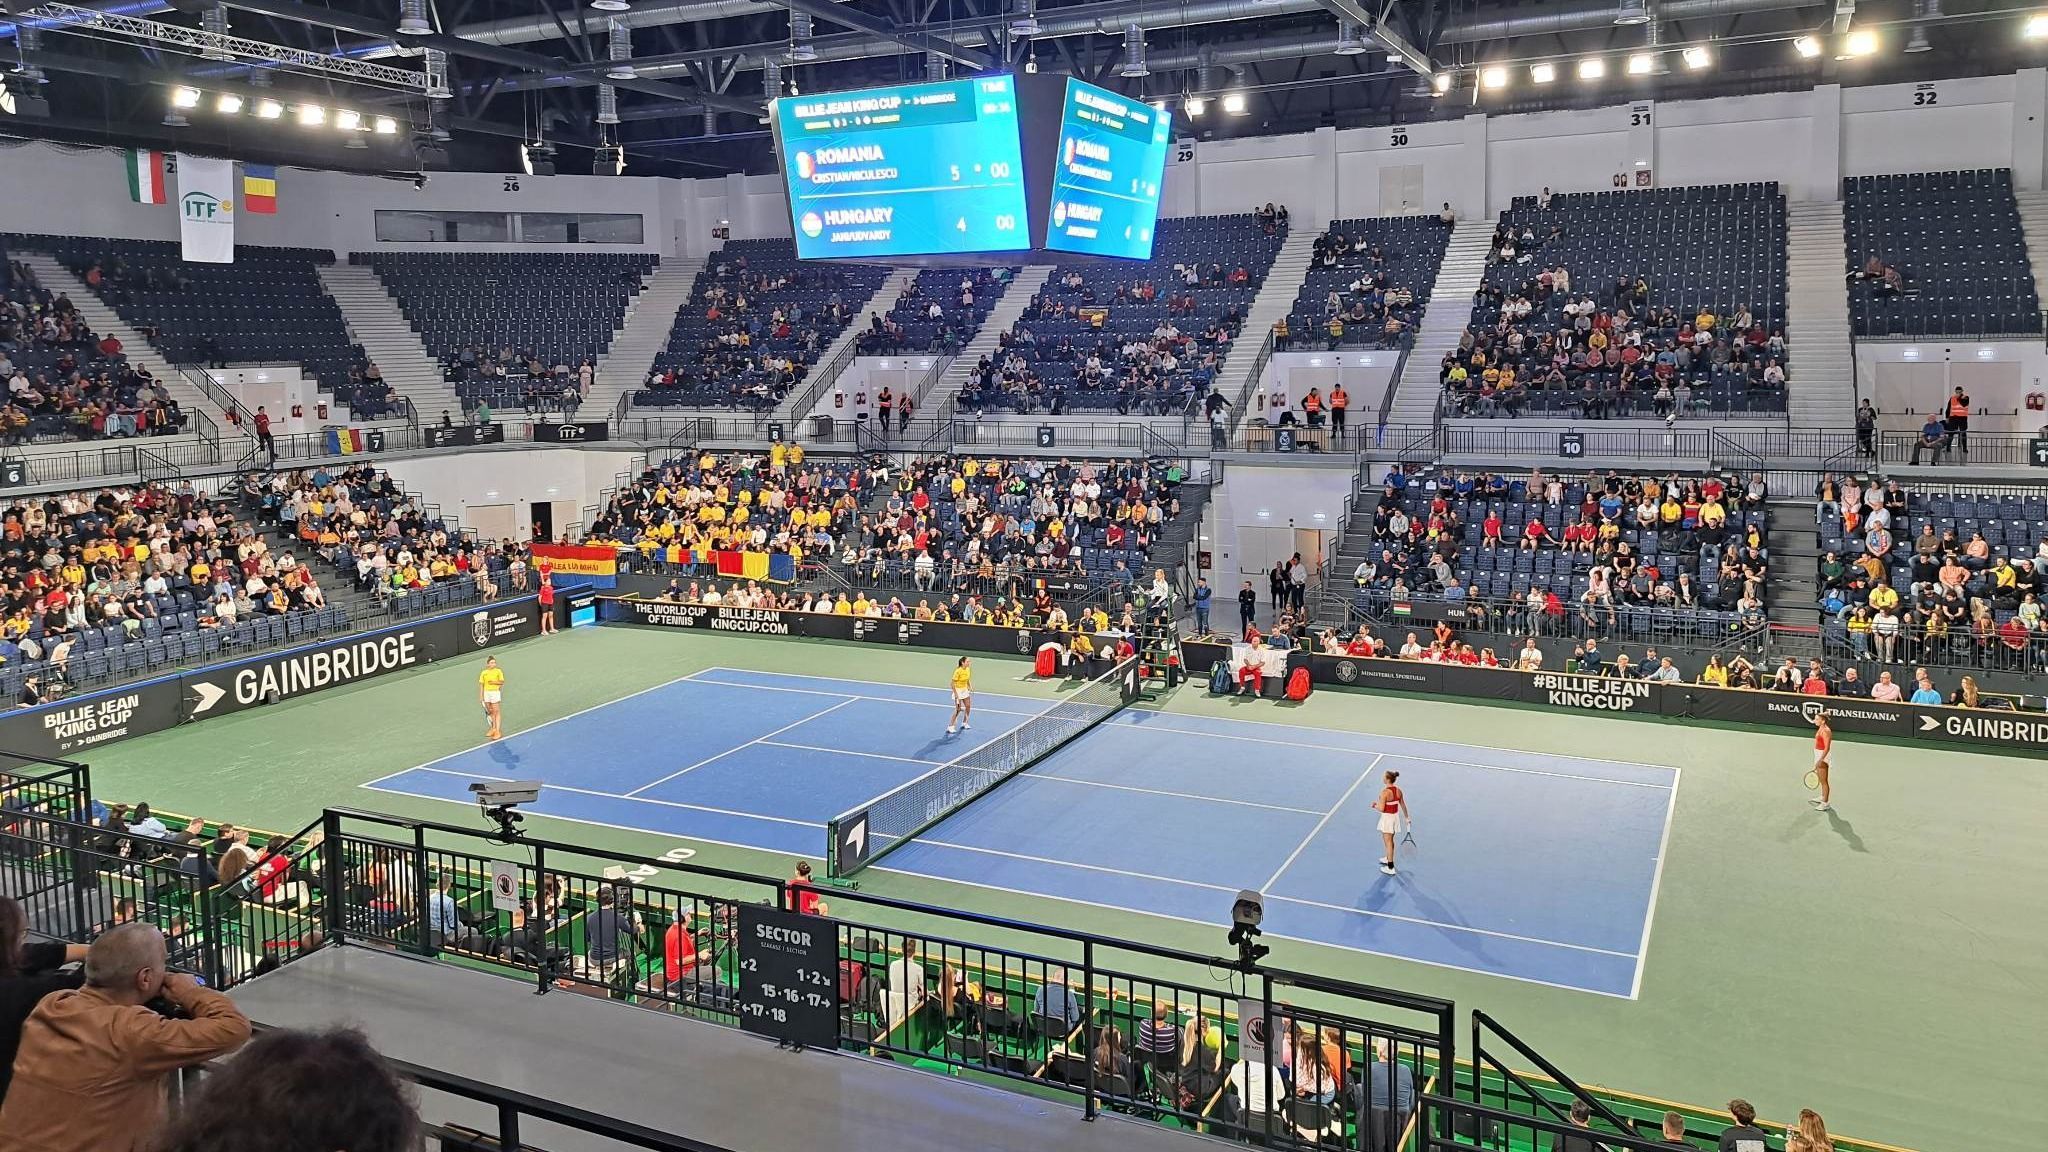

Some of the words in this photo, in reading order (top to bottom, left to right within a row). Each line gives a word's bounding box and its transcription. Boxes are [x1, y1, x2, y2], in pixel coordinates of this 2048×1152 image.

[879, 96, 901, 109] CUP
[1913, 91, 1937, 105] 32
[1631, 113, 1651, 126] 31
[1390, 134, 1408, 147] 30
[1177, 150, 1194, 162] 29
[166, 163, 178, 173] 2
[815, 145, 884, 165] ROMANIA
[951, 165, 960, 181] 5
[990, 162, 1010, 178] 00
[503, 182, 520, 191] 26
[185, 200, 218, 218] ITF
[824, 207, 893, 226] HUNGARY
[956, 216, 966, 232] 4
[560, 429, 577, 438] ITF
[772, 430, 779, 440] 8
[1042, 434, 1050, 445] 9
[373, 439, 379, 449] 7
[1563, 442, 1581, 454] 10
[8, 470, 20, 483] 6
[635, 603, 653, 614] THE
[653, 605, 688, 616] WORLD
[688, 607, 707, 617] CUP
[718, 609, 780, 622] BILLIEJEAN
[1447, 609, 1465, 617] HUN
[648, 615, 662, 624] OF
[661, 616, 694, 626] TENNIS
[711, 618, 789, 635] KINGCUP.COM
[234, 631, 416, 705] GAINBRIDGE
[1533, 674, 1650, 698] #BILLIEJEAN
[1548, 690, 1634, 711] KINGCUP
[44, 705, 96, 729] BILLIE
[97, 694, 140, 716] JEAN
[1767, 703, 1800, 714] BANCA
[1806, 706, 1819, 715] BT
[55, 718, 98, 740] KING
[99, 709, 132, 728] CUP
[61, 742, 72, 750] BY
[85, 727, 129, 745] GAINBRIDGE
[756, 923, 812, 947] SECTOR
[749, 958, 757, 972] 2
